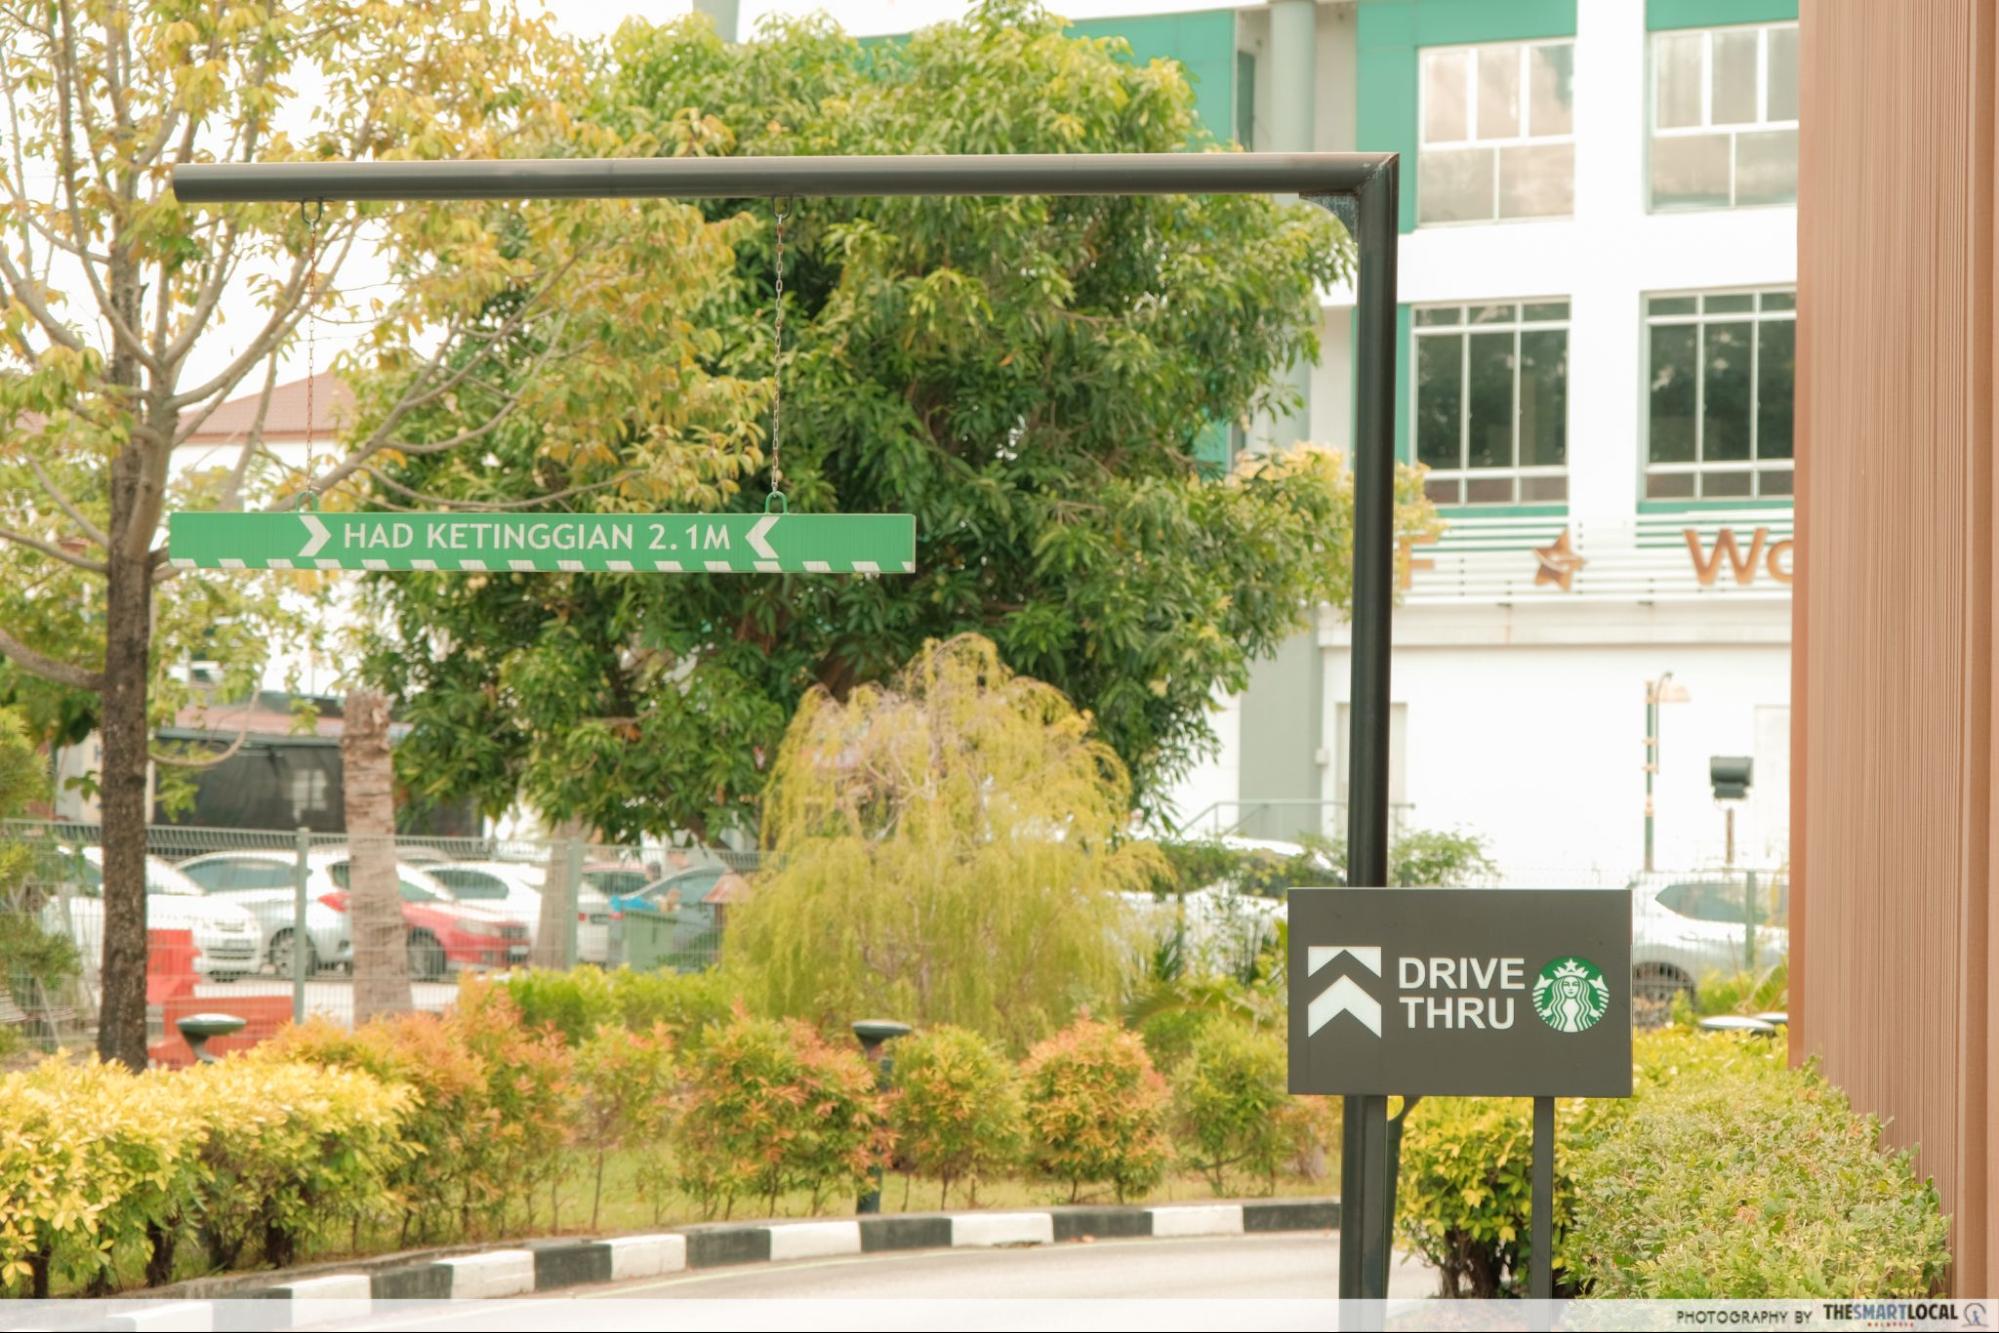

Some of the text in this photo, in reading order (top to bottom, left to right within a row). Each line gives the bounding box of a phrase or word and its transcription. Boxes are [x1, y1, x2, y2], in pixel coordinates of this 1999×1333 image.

[344, 522, 731, 551] HAD KETINGGIAN 2.1M
[1398, 957, 1525, 990] DRIVE
[1398, 997, 1515, 1030] THRU
